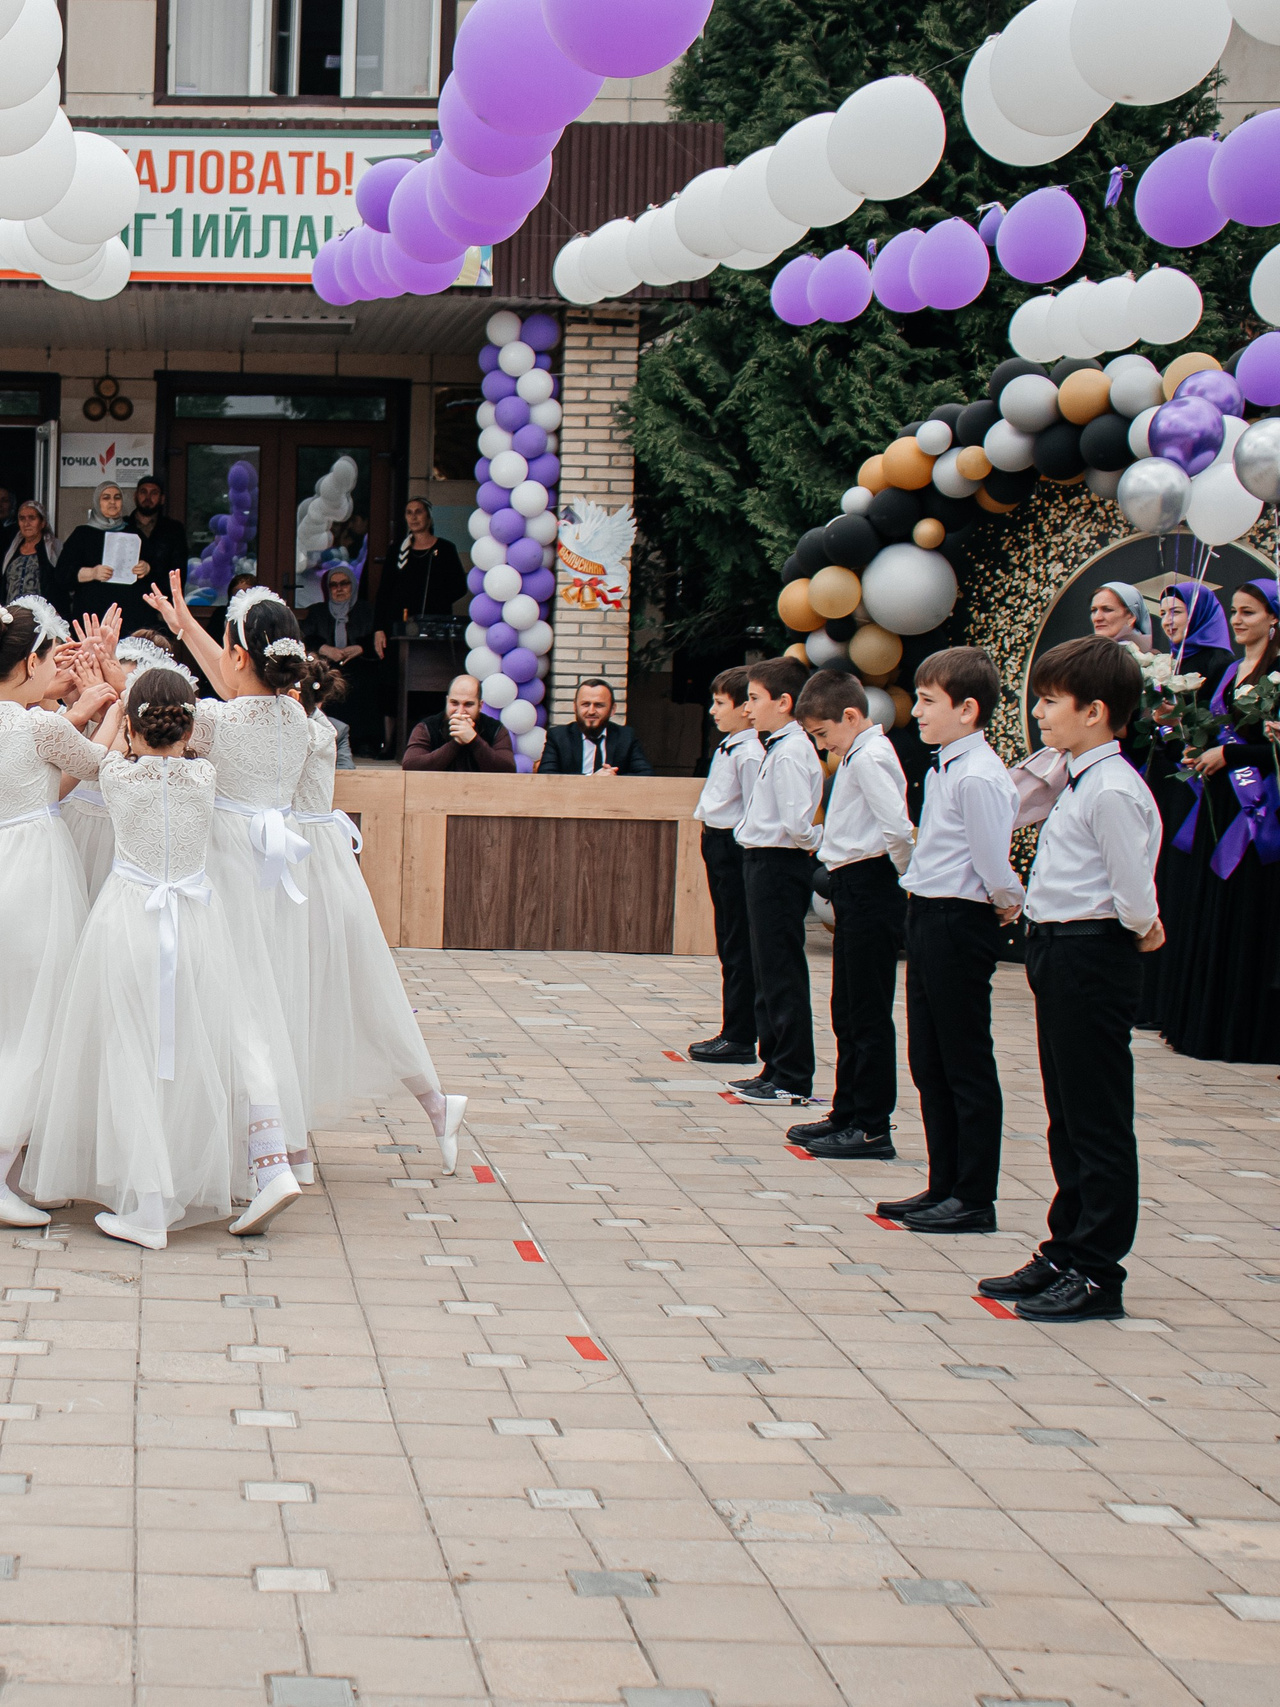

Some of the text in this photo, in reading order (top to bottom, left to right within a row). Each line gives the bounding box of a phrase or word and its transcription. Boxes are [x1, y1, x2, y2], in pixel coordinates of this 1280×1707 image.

[124, 149, 354, 196] АЛОВАТЬ!
[62, 456, 149, 467] ТОЧКА РОСТА
